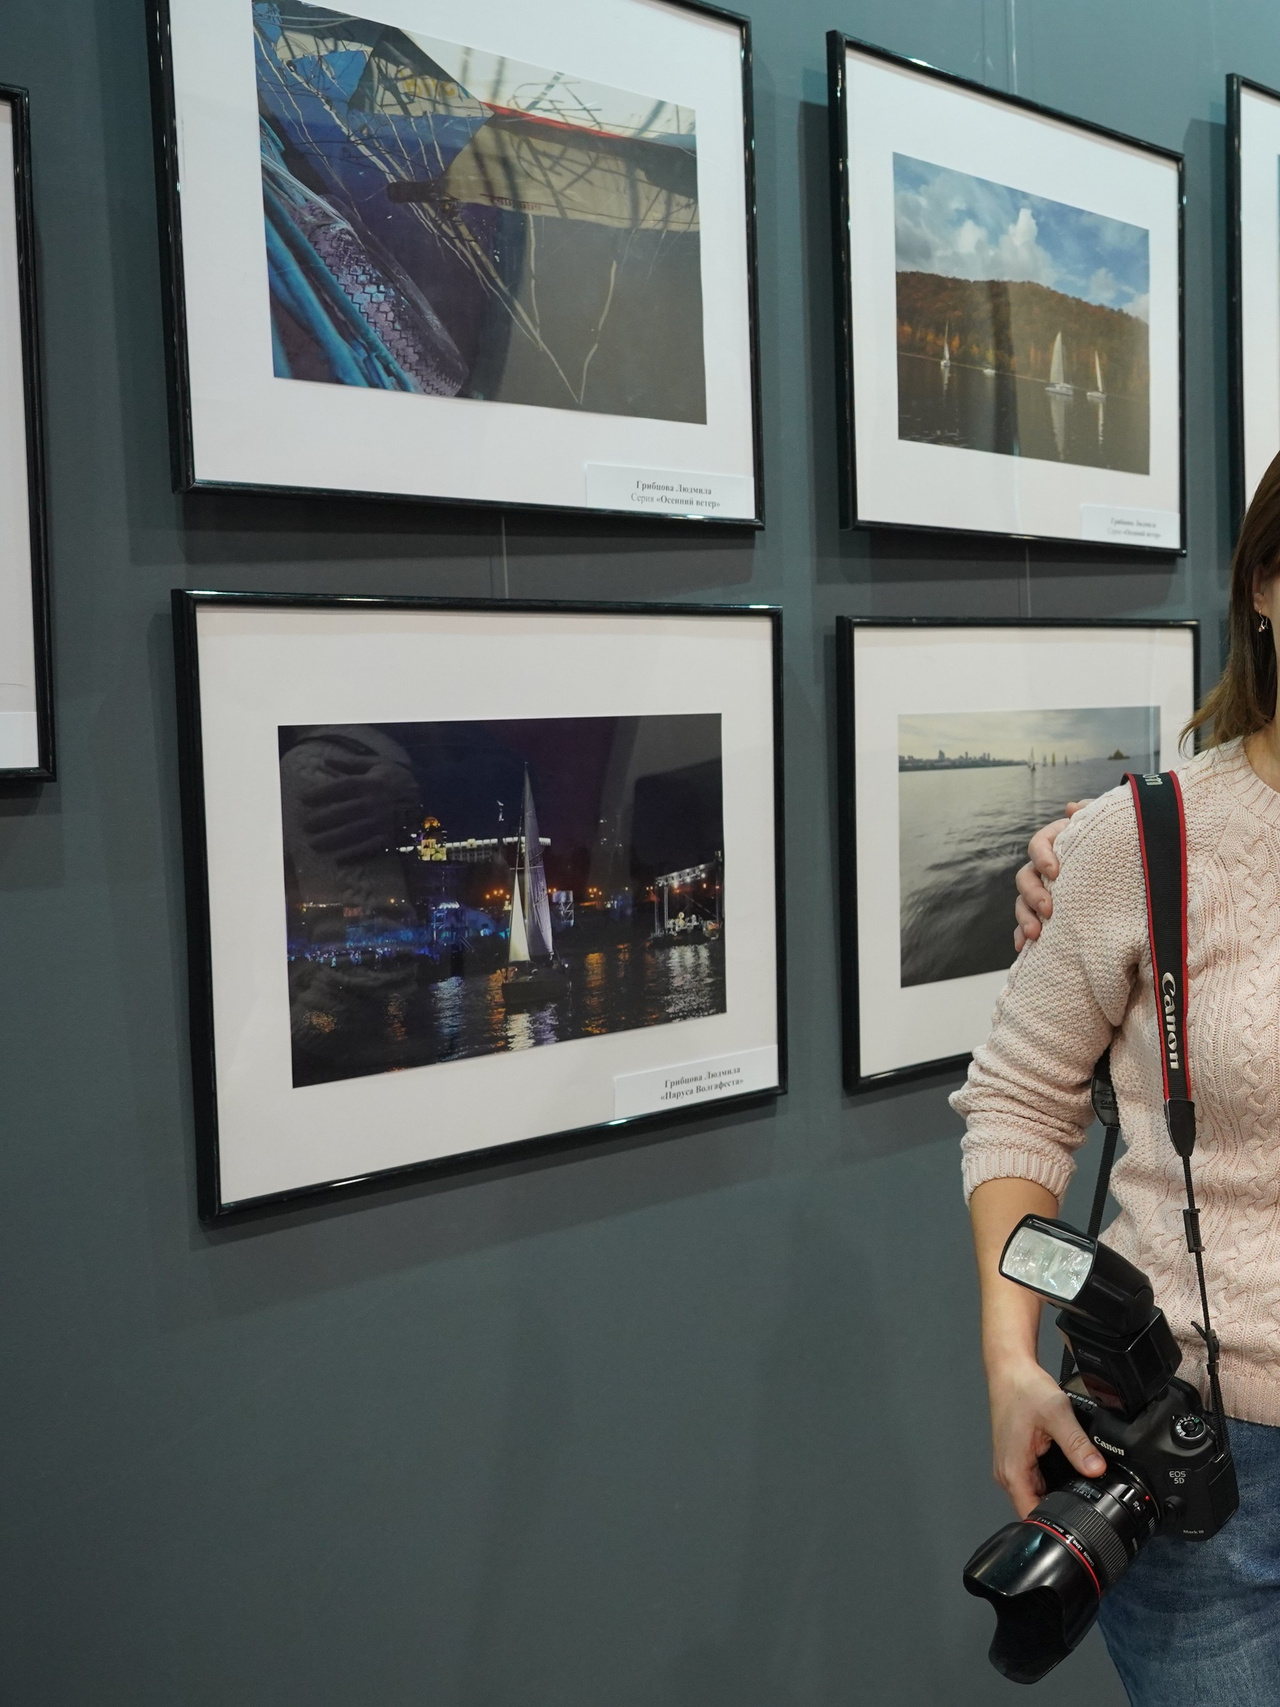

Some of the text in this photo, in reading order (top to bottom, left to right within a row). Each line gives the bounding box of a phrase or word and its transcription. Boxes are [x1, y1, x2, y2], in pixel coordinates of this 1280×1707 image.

[636, 480, 712, 495] Грибцова Людмила
[630, 492, 721, 509] Серия «Осенний ветер»
[1161, 971, 1179, 1070] Canon
[664, 1067, 741, 1089] Грибцова Людмила
[660, 1089, 694, 1100] «Паруса
[1093, 1436, 1125, 1456] Canon
[1169, 1470, 1186, 1478] EOS
[1174, 1477, 1185, 1485] 5D
[1083, 1551, 1095, 1567] CANON
